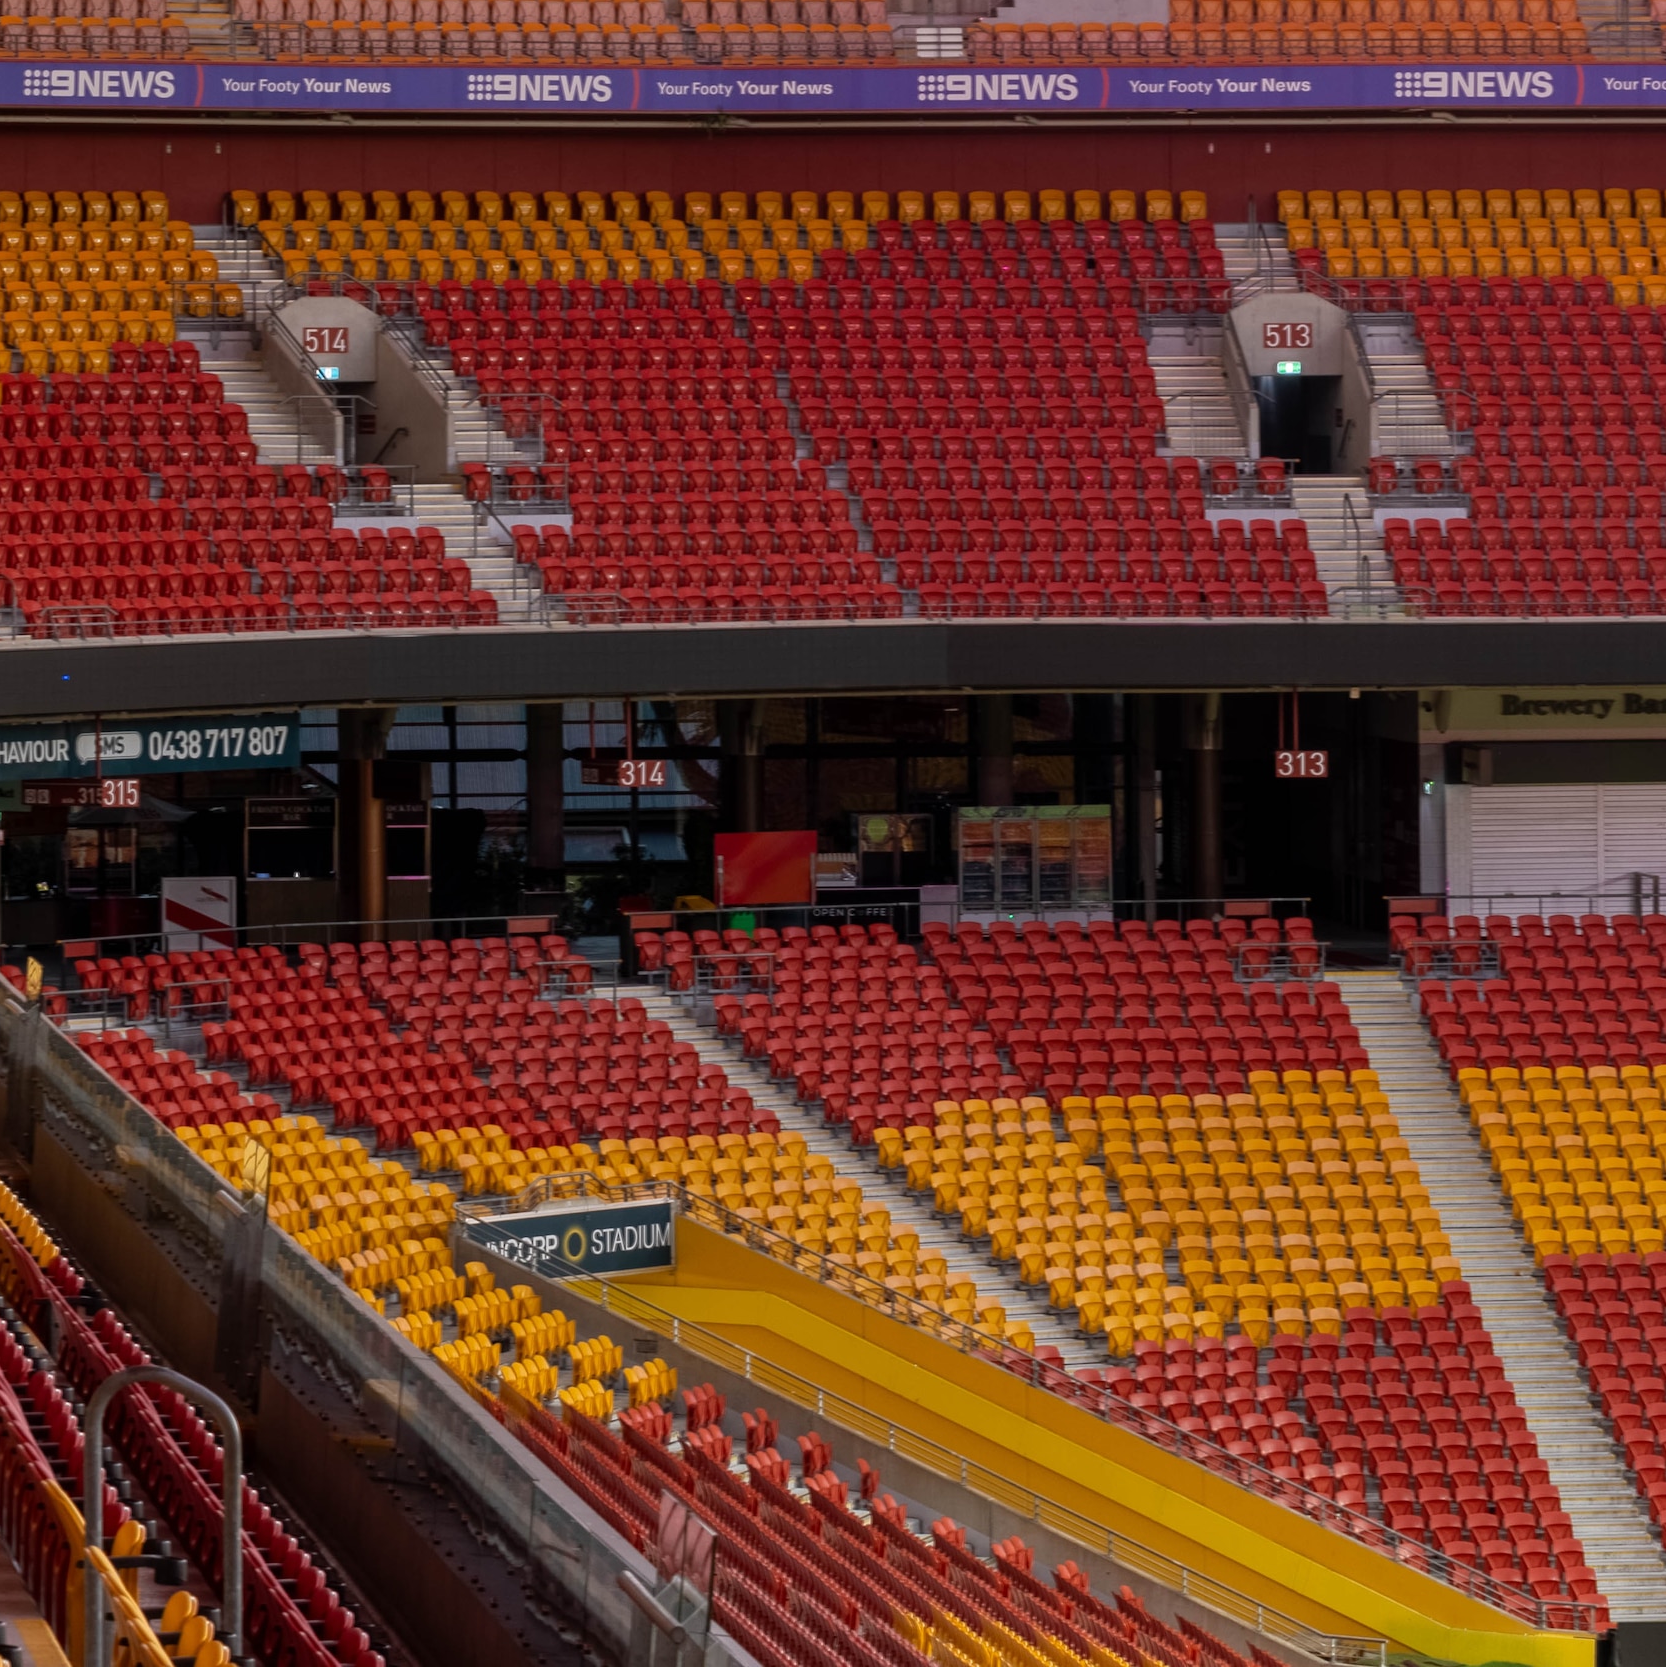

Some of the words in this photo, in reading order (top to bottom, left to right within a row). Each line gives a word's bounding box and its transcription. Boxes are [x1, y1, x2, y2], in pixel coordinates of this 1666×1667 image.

[223, 79, 256, 91] Your
[259, 79, 300, 94] Footy
[304, 78, 341, 92] Your
[346, 79, 391, 93] News
[658, 82, 689, 95] Your
[692, 82, 733, 97] Footy
[737, 81, 778, 94] Your
[783, 81, 833, 94] News
[1129, 81, 1165, 93] Your
[1169, 80, 1212, 95] Footy
[1217, 79, 1257, 92] Your
[1262, 78, 1311, 91] News
[1604, 78, 1639, 90] Your
[304, 329, 348, 353] 514
[1265, 324, 1312, 346] 513
[1500, 693, 1615, 719] Brewery
[149, 730, 201, 760] 0438
[205, 728, 245, 758] 717
[249, 726, 288, 756] 807
[620, 761, 665, 785] 314
[1276, 752, 1327, 776] 313
[102, 780, 139, 806] 315
[813, 908, 844, 917] OPEN
[848, 908, 894, 917] CFFE
[592, 1221, 670, 1255] STADIUM
